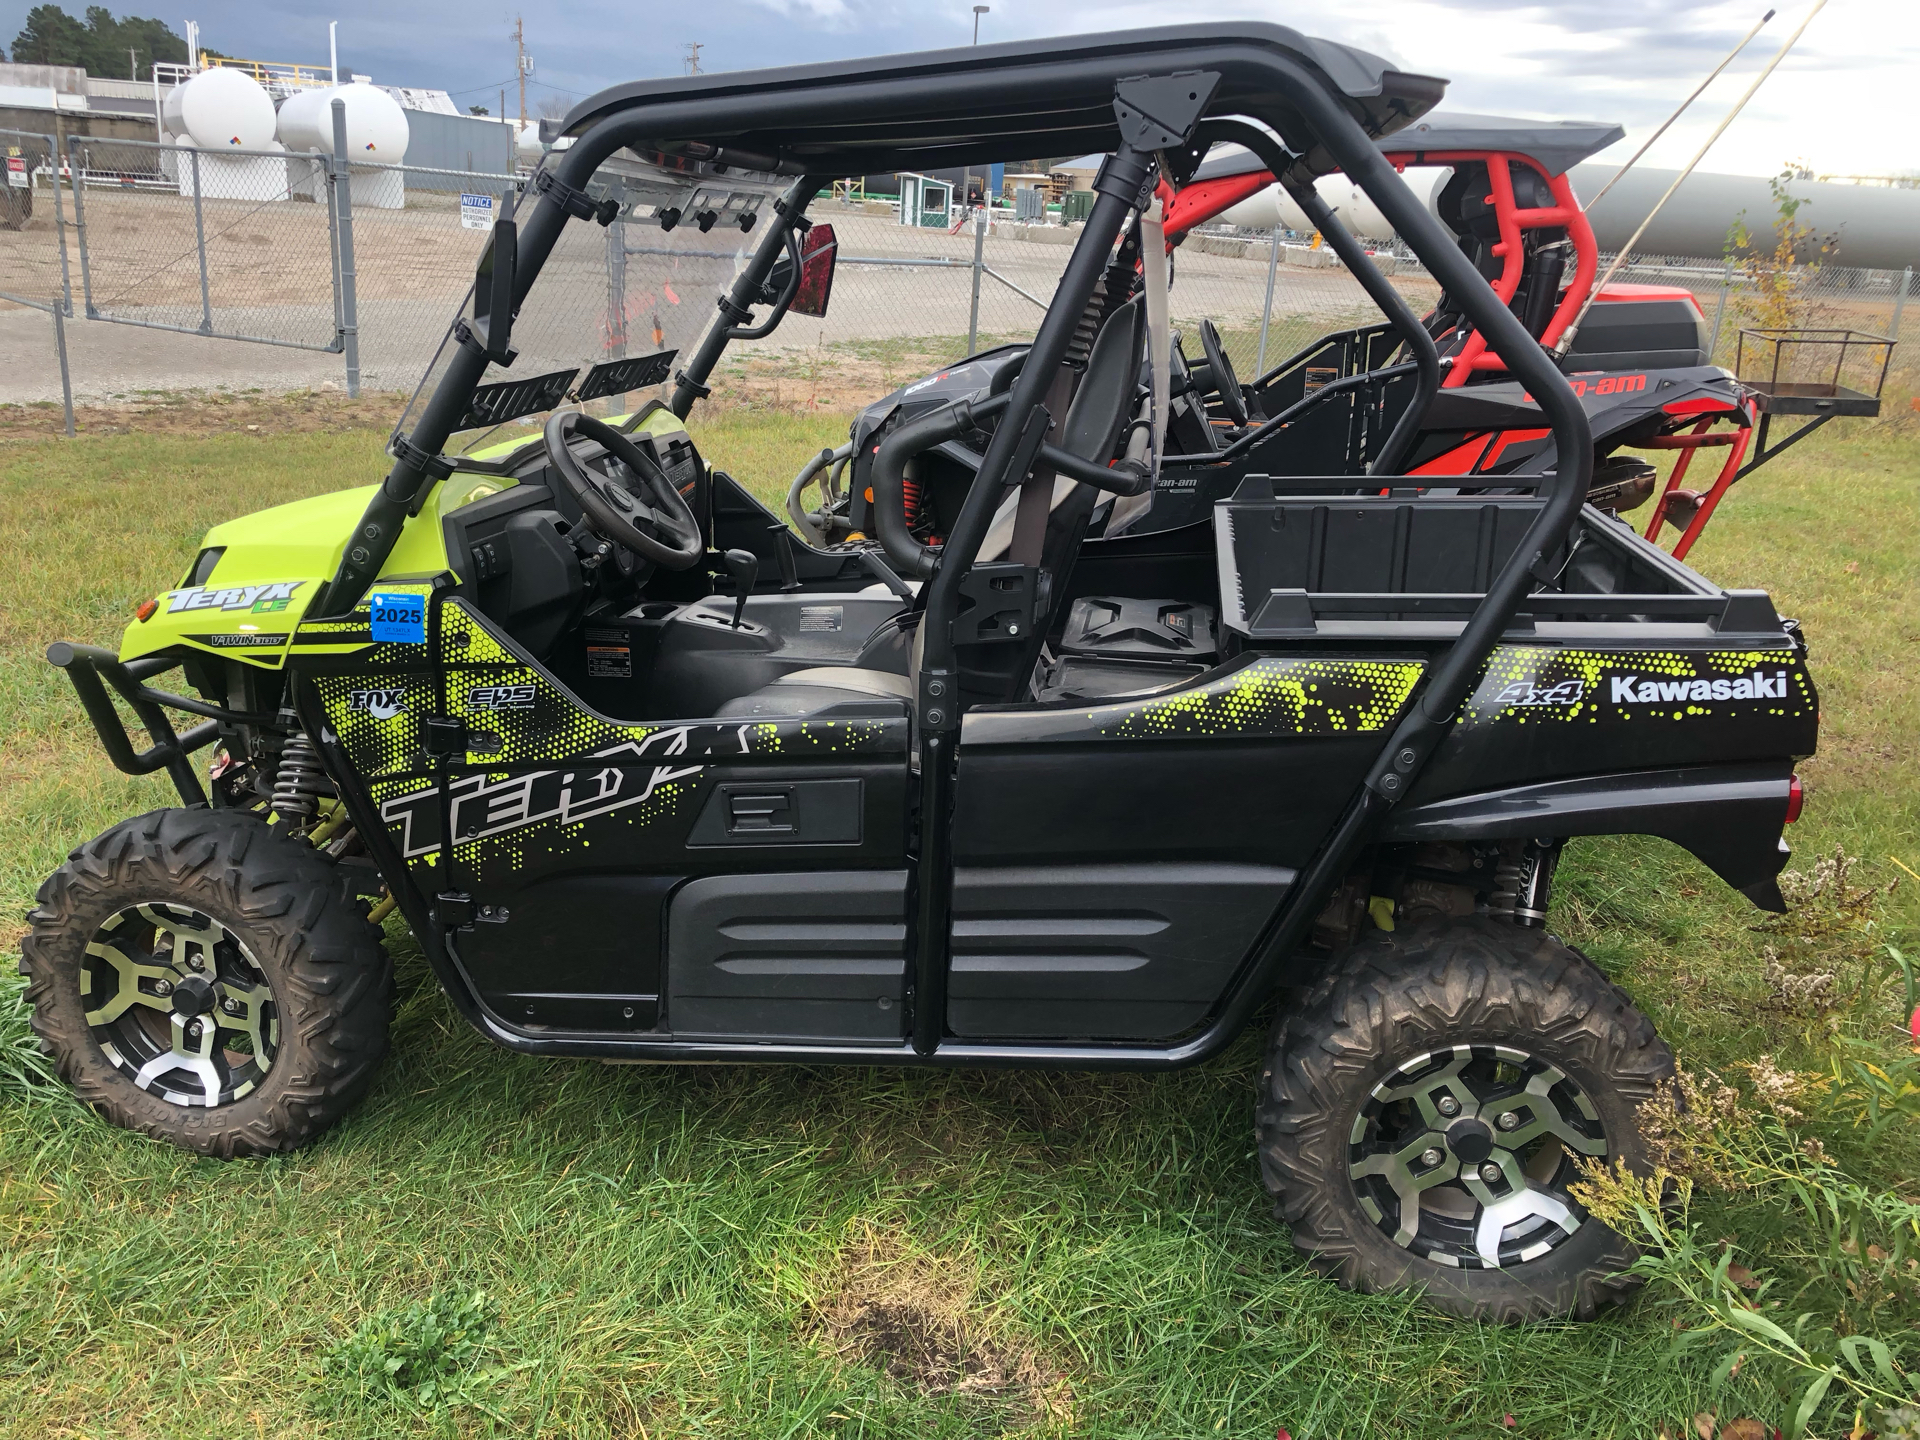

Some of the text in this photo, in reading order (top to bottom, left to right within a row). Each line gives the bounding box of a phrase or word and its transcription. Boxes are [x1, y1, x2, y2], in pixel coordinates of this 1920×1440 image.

[462, 195, 491, 208] NOTICE
[462, 207, 492, 216] AUTHORIZED
[463, 213, 491, 223] PERSONNEL
[166, 580, 307, 614] TERYX
[251, 598, 295, 614] LE
[375, 607, 421, 624] 2025
[211, 633, 254, 646] V-TWIN
[1494, 681, 1584, 705] 4x4
[1611, 671, 1788, 703] Kawasaki
[350, 688, 406, 710] FOX
[468, 685, 536, 707] EPS
